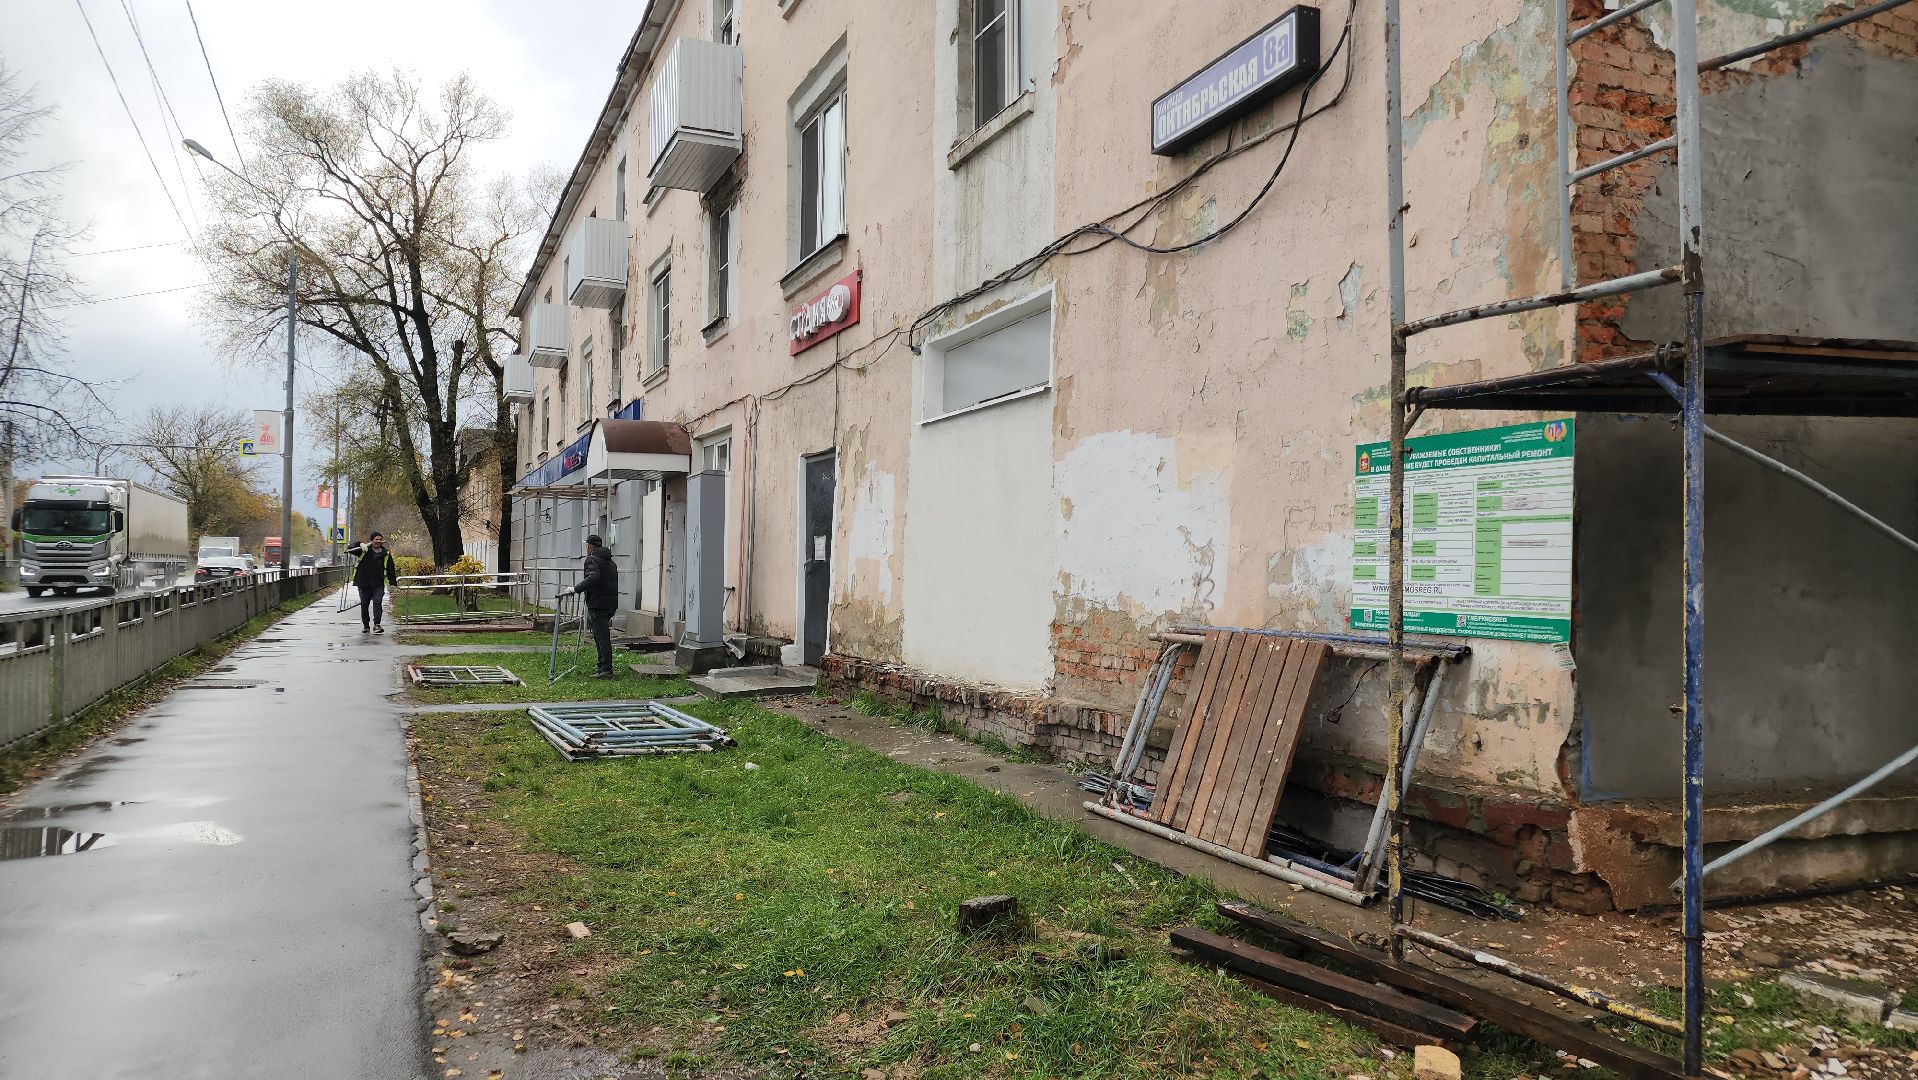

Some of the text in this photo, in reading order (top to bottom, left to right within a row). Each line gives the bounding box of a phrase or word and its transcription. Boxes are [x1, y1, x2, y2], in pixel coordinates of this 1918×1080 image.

[1157, 55, 1258, 140] ОКТЯБРЬСКАЯ
[1414, 460, 1434, 470] БУДЕТ
[1468, 450, 1521, 464] КАПИТАЛЬНЫЙ
[1521, 448, 1553, 459] РЕМОНТ
[1448, 443, 1502, 457] СОБСТВЕННИКИ!
